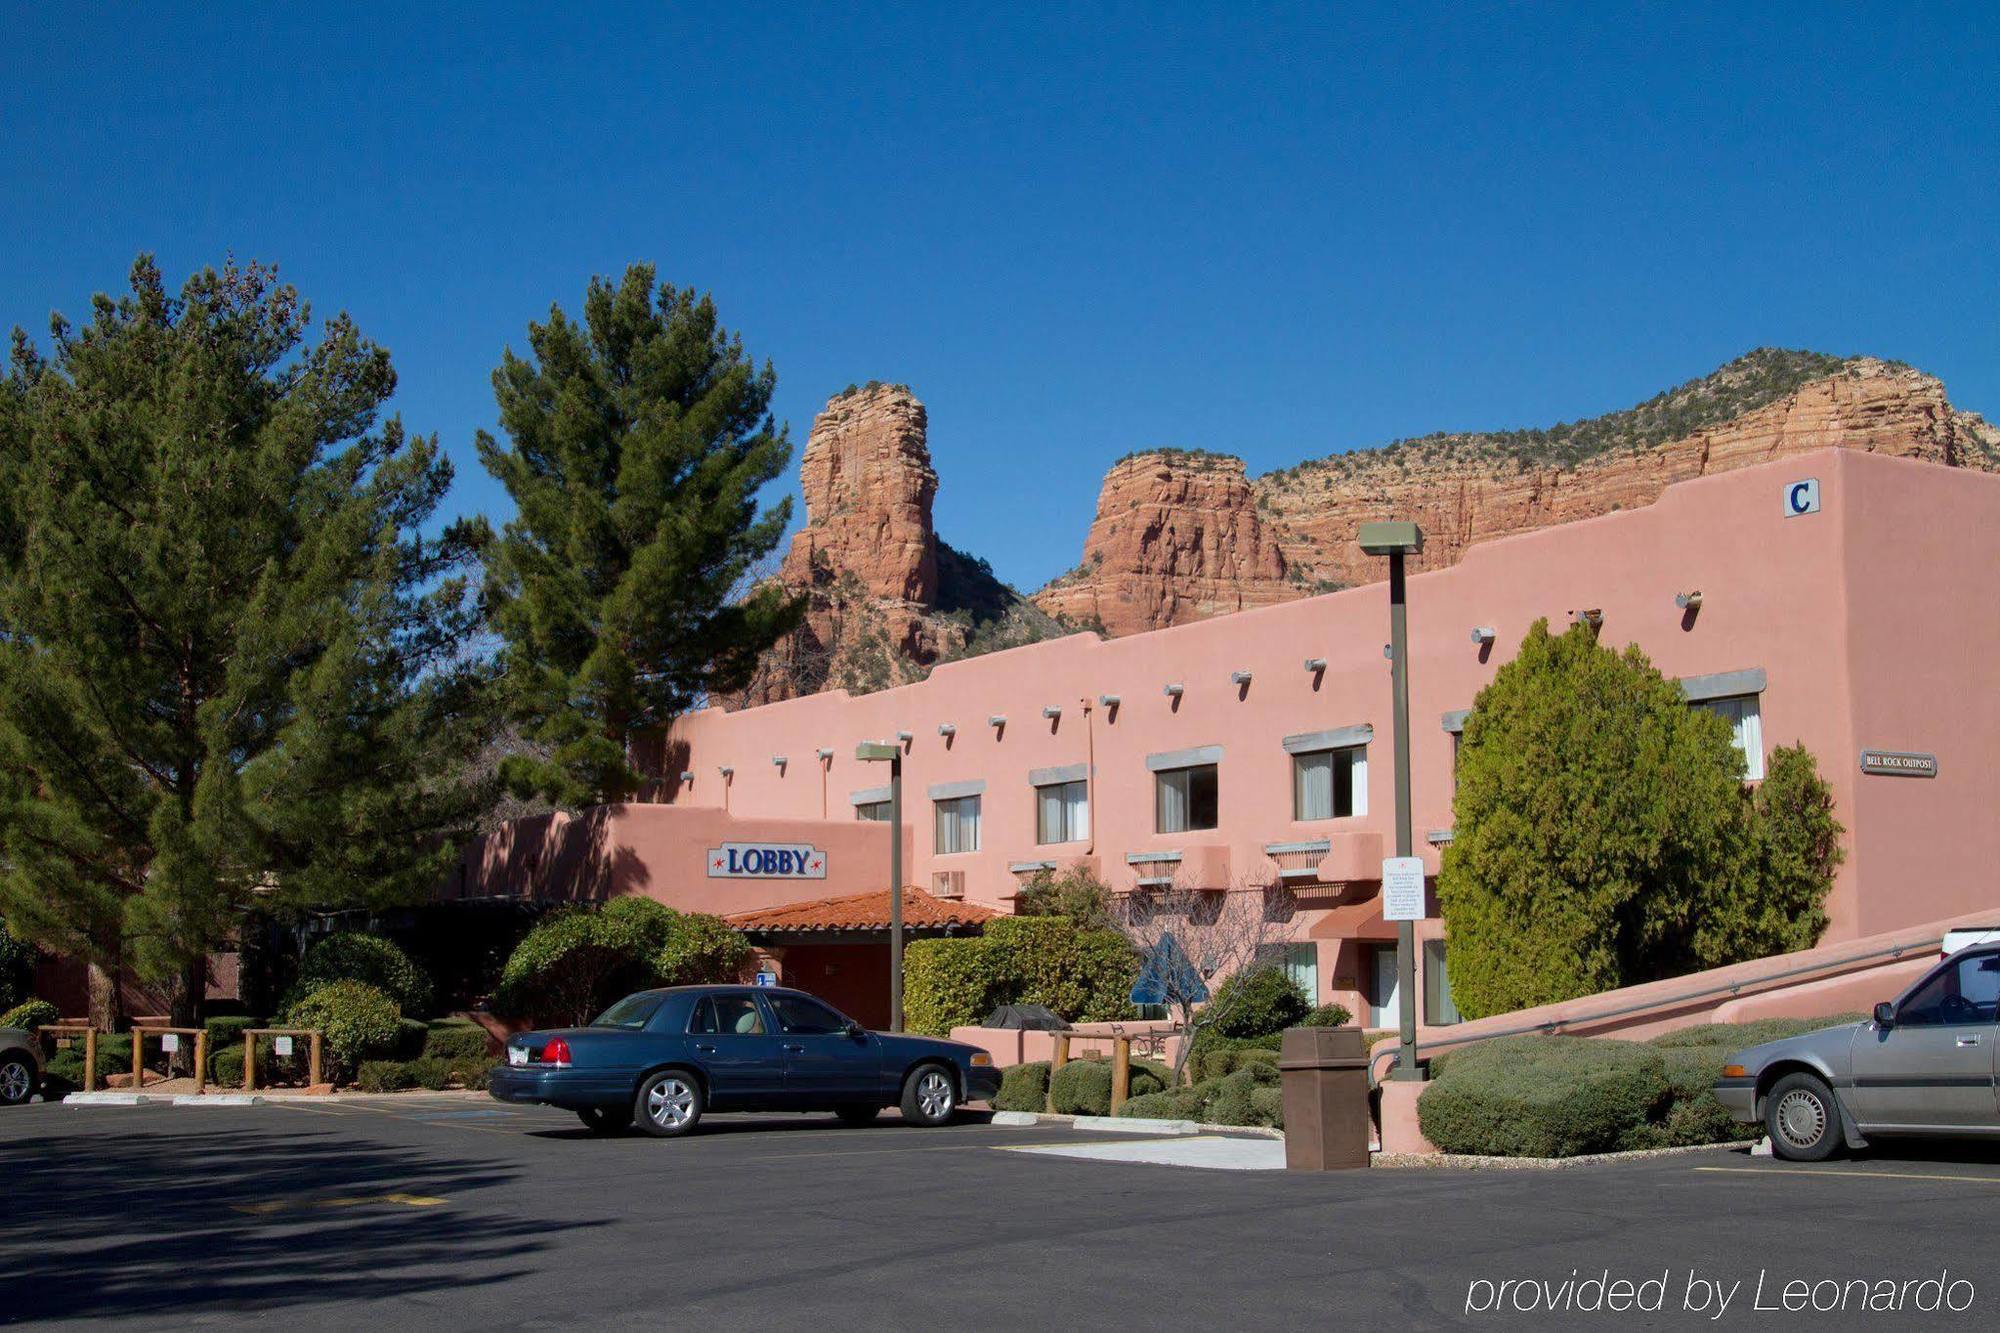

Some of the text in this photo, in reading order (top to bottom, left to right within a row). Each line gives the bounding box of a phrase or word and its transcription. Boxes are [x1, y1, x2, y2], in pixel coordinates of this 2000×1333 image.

[1791, 482, 1810, 513] C
[1866, 755, 1932, 769] BELL ROCK OUTPOST
[727, 848, 810, 875] LOBBY
